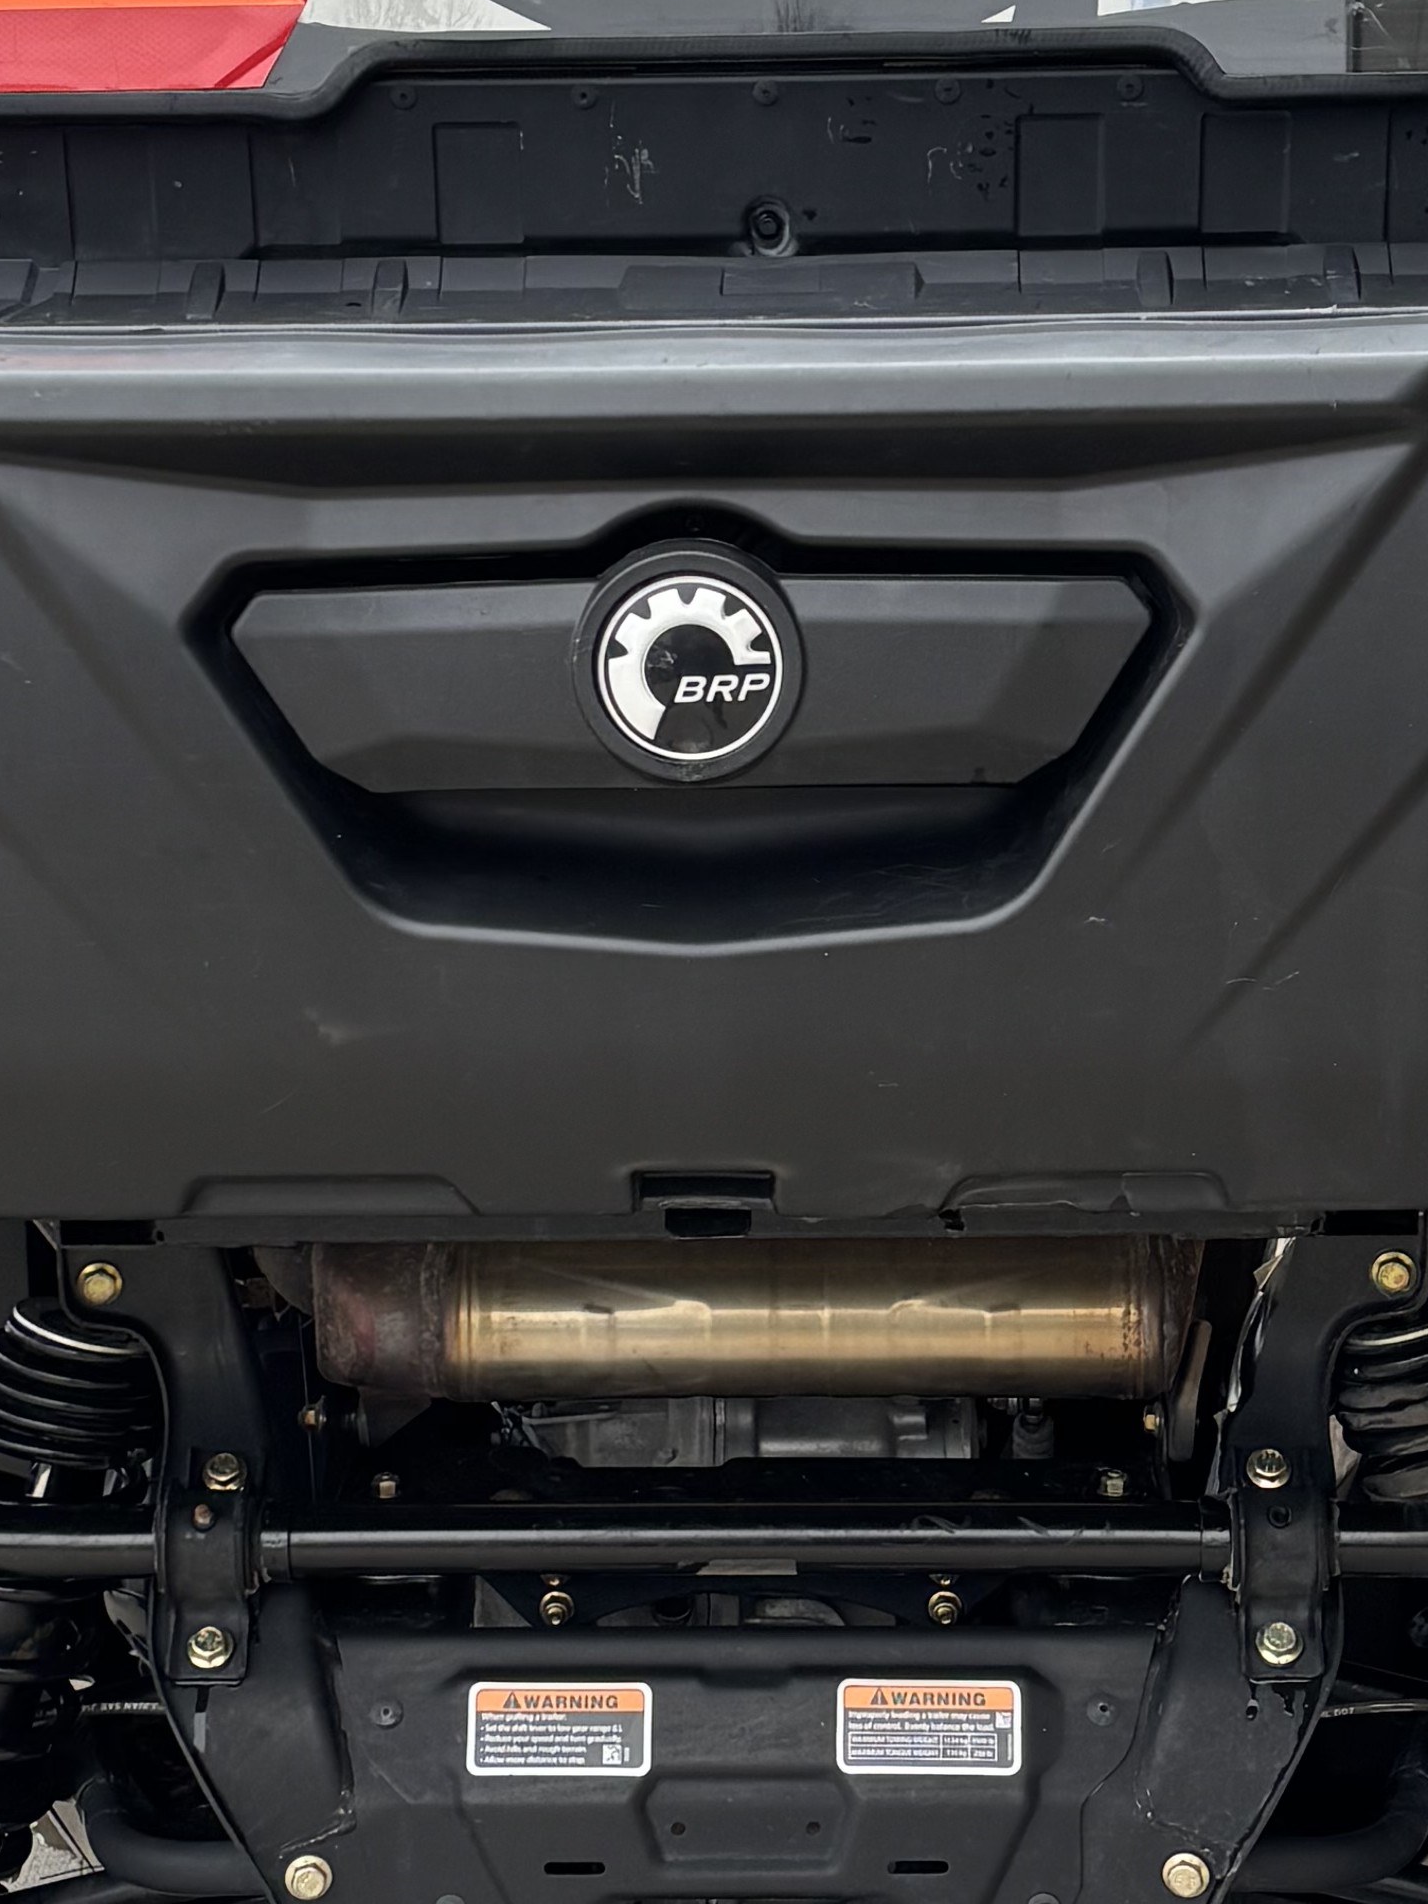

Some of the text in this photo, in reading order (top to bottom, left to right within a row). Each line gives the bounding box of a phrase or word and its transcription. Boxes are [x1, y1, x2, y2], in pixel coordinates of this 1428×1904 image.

[674, 673, 771, 704] BRP
[523, 1694, 619, 1709] WARNING
[891, 1692, 986, 1706] WARNING
